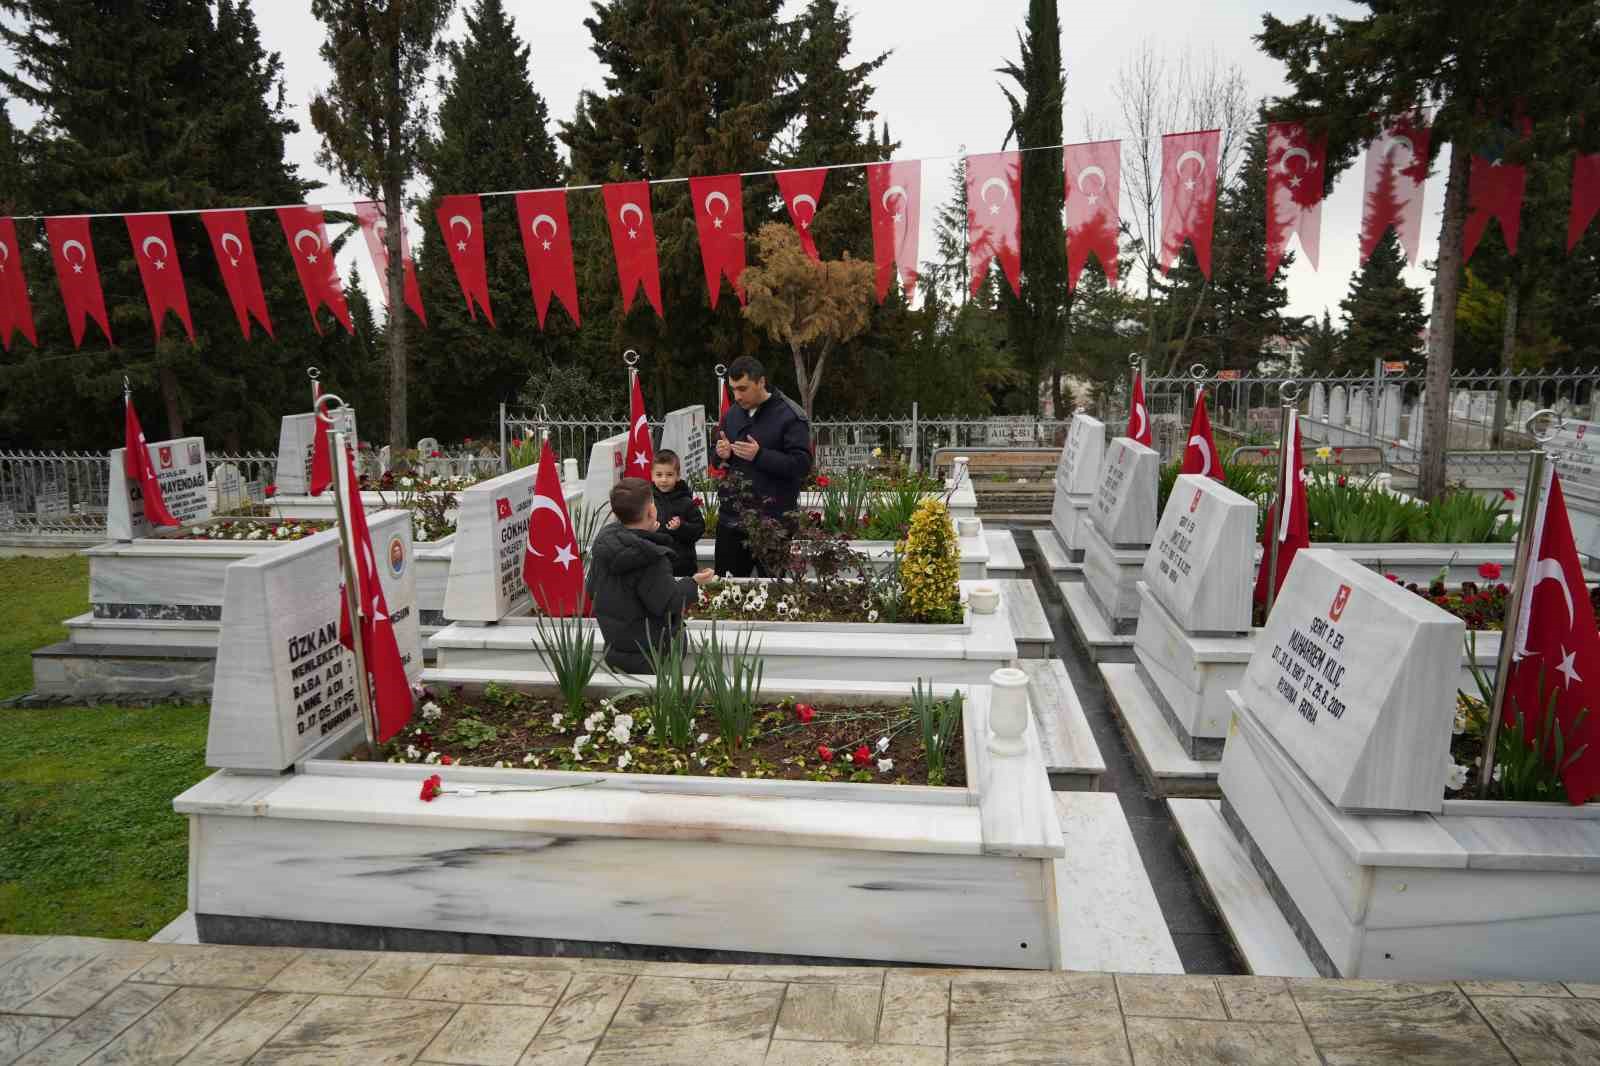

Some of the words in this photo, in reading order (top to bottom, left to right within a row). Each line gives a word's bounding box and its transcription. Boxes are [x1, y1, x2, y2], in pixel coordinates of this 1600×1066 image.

[288, 621, 337, 663] ÖZKAN
[1288, 628, 1327, 673] MUHARREM
[1322, 657, 1346, 690] KILIÇ
[293, 675, 321, 700] BABA
[326, 661, 343, 681] ADI
[296, 692, 322, 718] ANNE
[327, 678, 344, 698] ADI
[1277, 676, 1298, 705] RUHUNA
